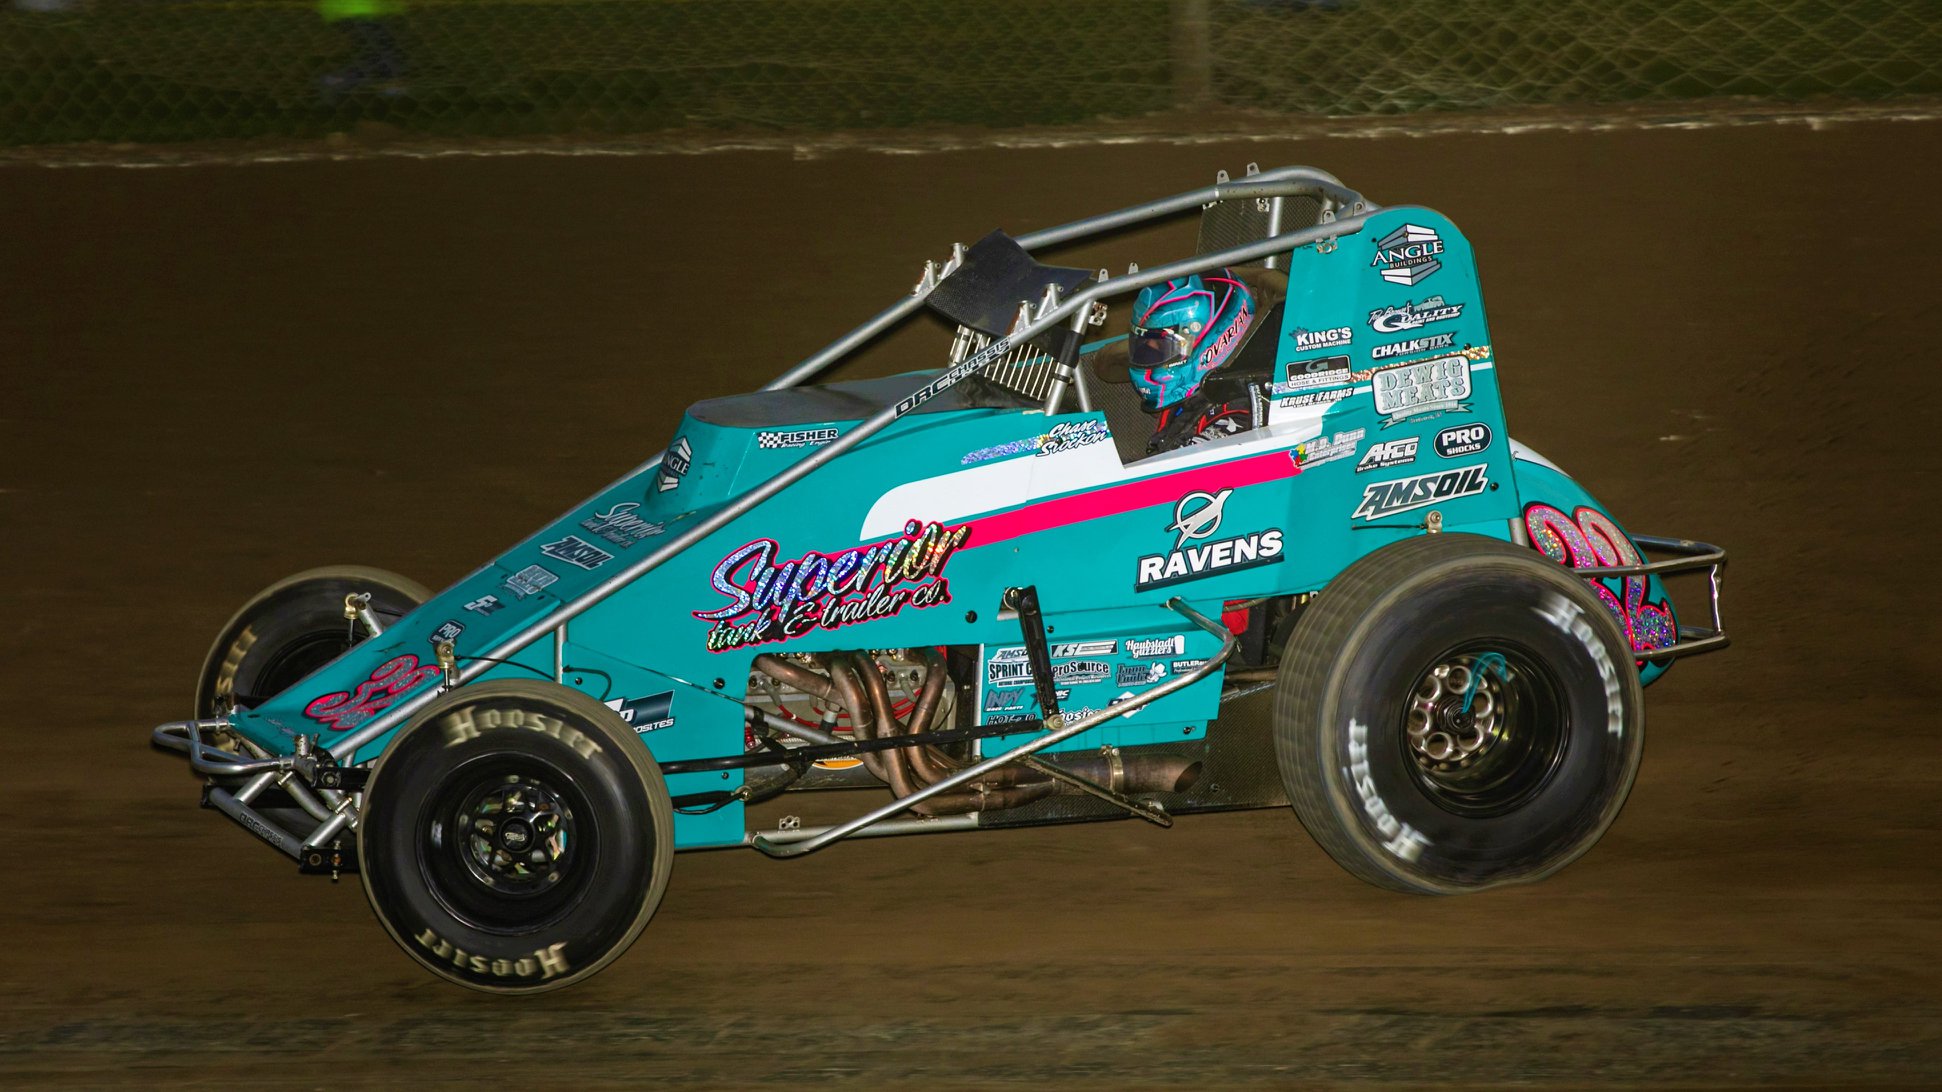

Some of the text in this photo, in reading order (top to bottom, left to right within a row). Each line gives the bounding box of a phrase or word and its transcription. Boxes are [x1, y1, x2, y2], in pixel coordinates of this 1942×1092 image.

[1373, 240, 1444, 266] ANGLE
[1389, 256, 1433, 269] BUILDINGS
[1373, 305, 1463, 332] QUALITY
[1205, 307, 1248, 364] OVARIAN
[1296, 327, 1352, 345] KING'S
[1296, 339, 1351, 352] CUSTOM MACHINE
[1372, 333, 1454, 358] CHALKSTIX
[896, 338, 1010, 417] DRC CHASSIS
[1290, 368, 1348, 381] GOODRIDGE
[1291, 379, 1309, 387] HOSE
[1318, 375, 1349, 383] FITTINGS
[1378, 359, 1464, 392] DEWIG
[1281, 394, 1316, 407] KRUSE
[1318, 387, 1353, 402] FARMS
[1381, 378, 1466, 411] MEATS
[780, 429, 838, 443] FISHER
[1049, 420, 1097, 437] Chase
[1442, 426, 1485, 446] PRO
[780, 441, 805, 449] Racing
[1359, 437, 1419, 466] AFCO
[1446, 443, 1481, 456] SHOCKS
[1380, 458, 1415, 467] Systems
[1358, 467, 1488, 518] AMSOIL
[545, 536, 612, 568] AMSOIL
[1139, 530, 1283, 584] RAVENS
[697, 521, 967, 622] Superior
[707, 609, 771, 650] tank
[821, 585, 905, 628] trailer
[438, 622, 461, 638] PRO
[1132, 646, 1172, 659] Guzzlers
[989, 663, 1023, 680] SPRINT
[1052, 661, 1110, 678] ProSource
[441, 706, 603, 759] Hoosier
[415, 929, 570, 979] Hoosier
